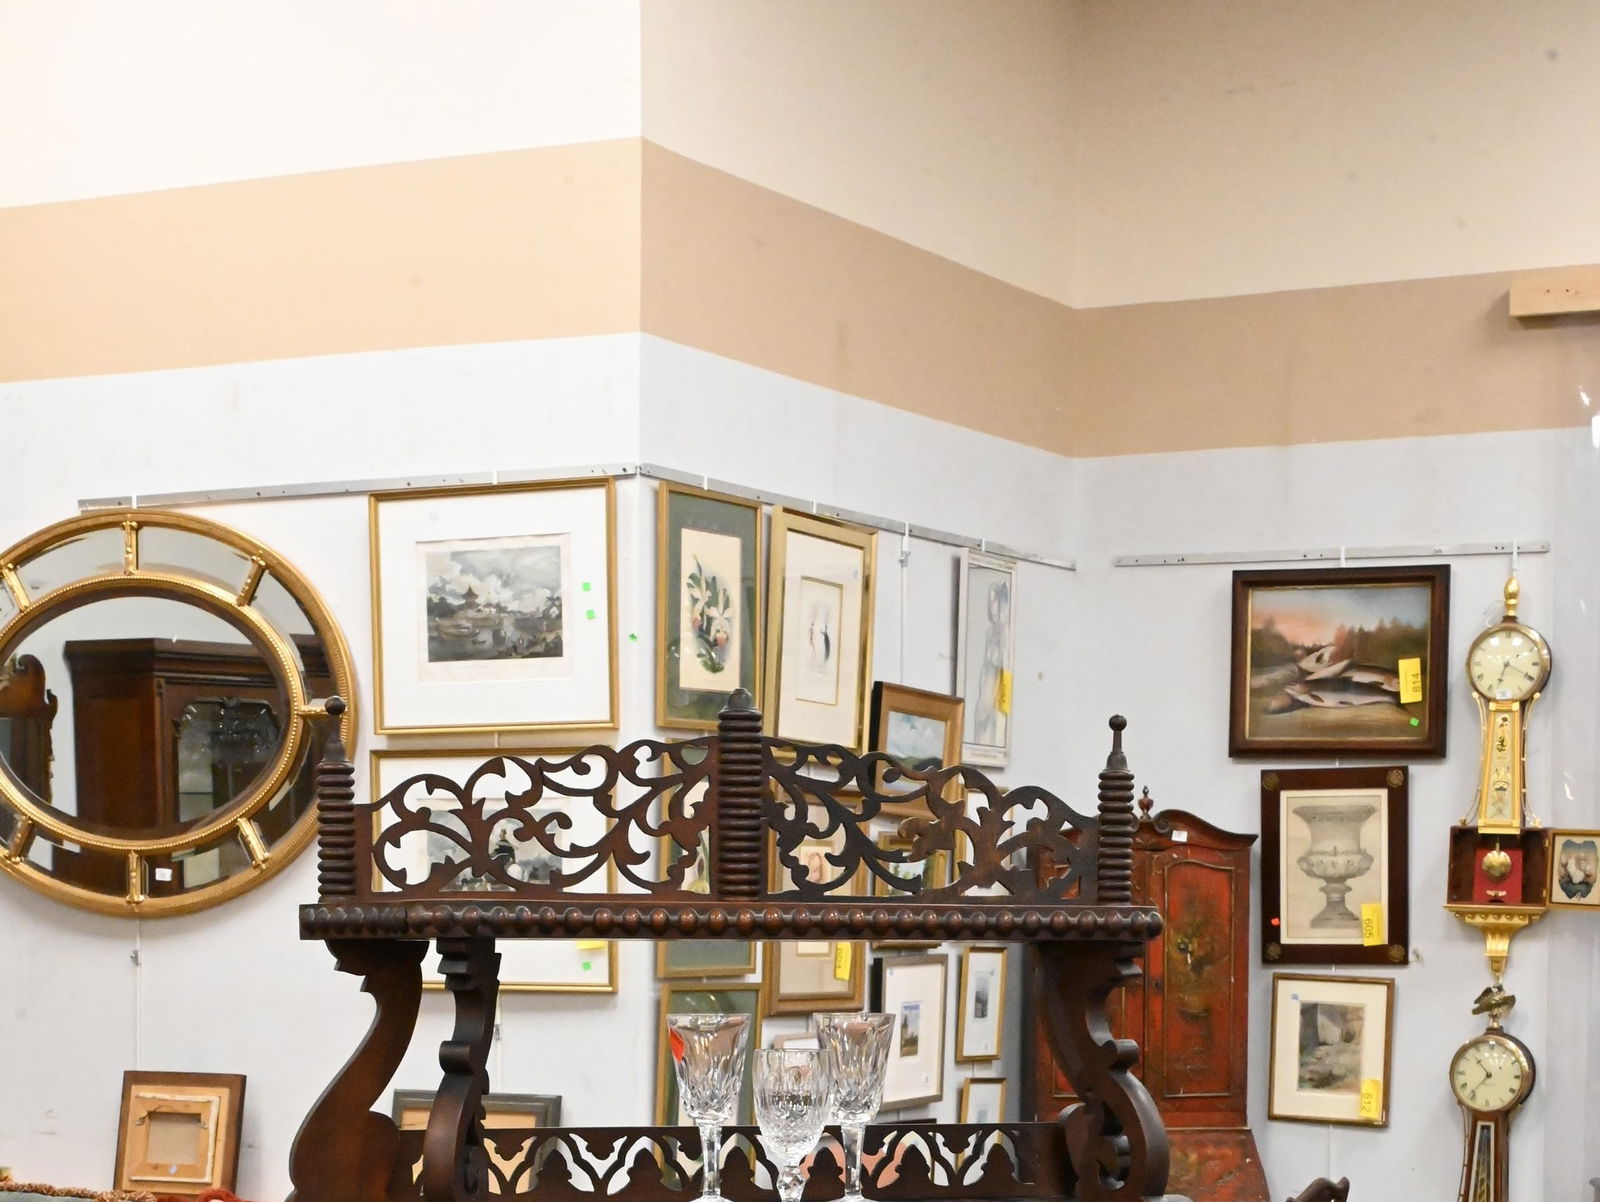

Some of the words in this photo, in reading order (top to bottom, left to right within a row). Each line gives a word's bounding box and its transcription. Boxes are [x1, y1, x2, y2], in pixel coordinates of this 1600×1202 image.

[1411, 672, 1421, 693] 814
[1363, 918, 1374, 939] 605
[1360, 1092, 1373, 1113] 612
